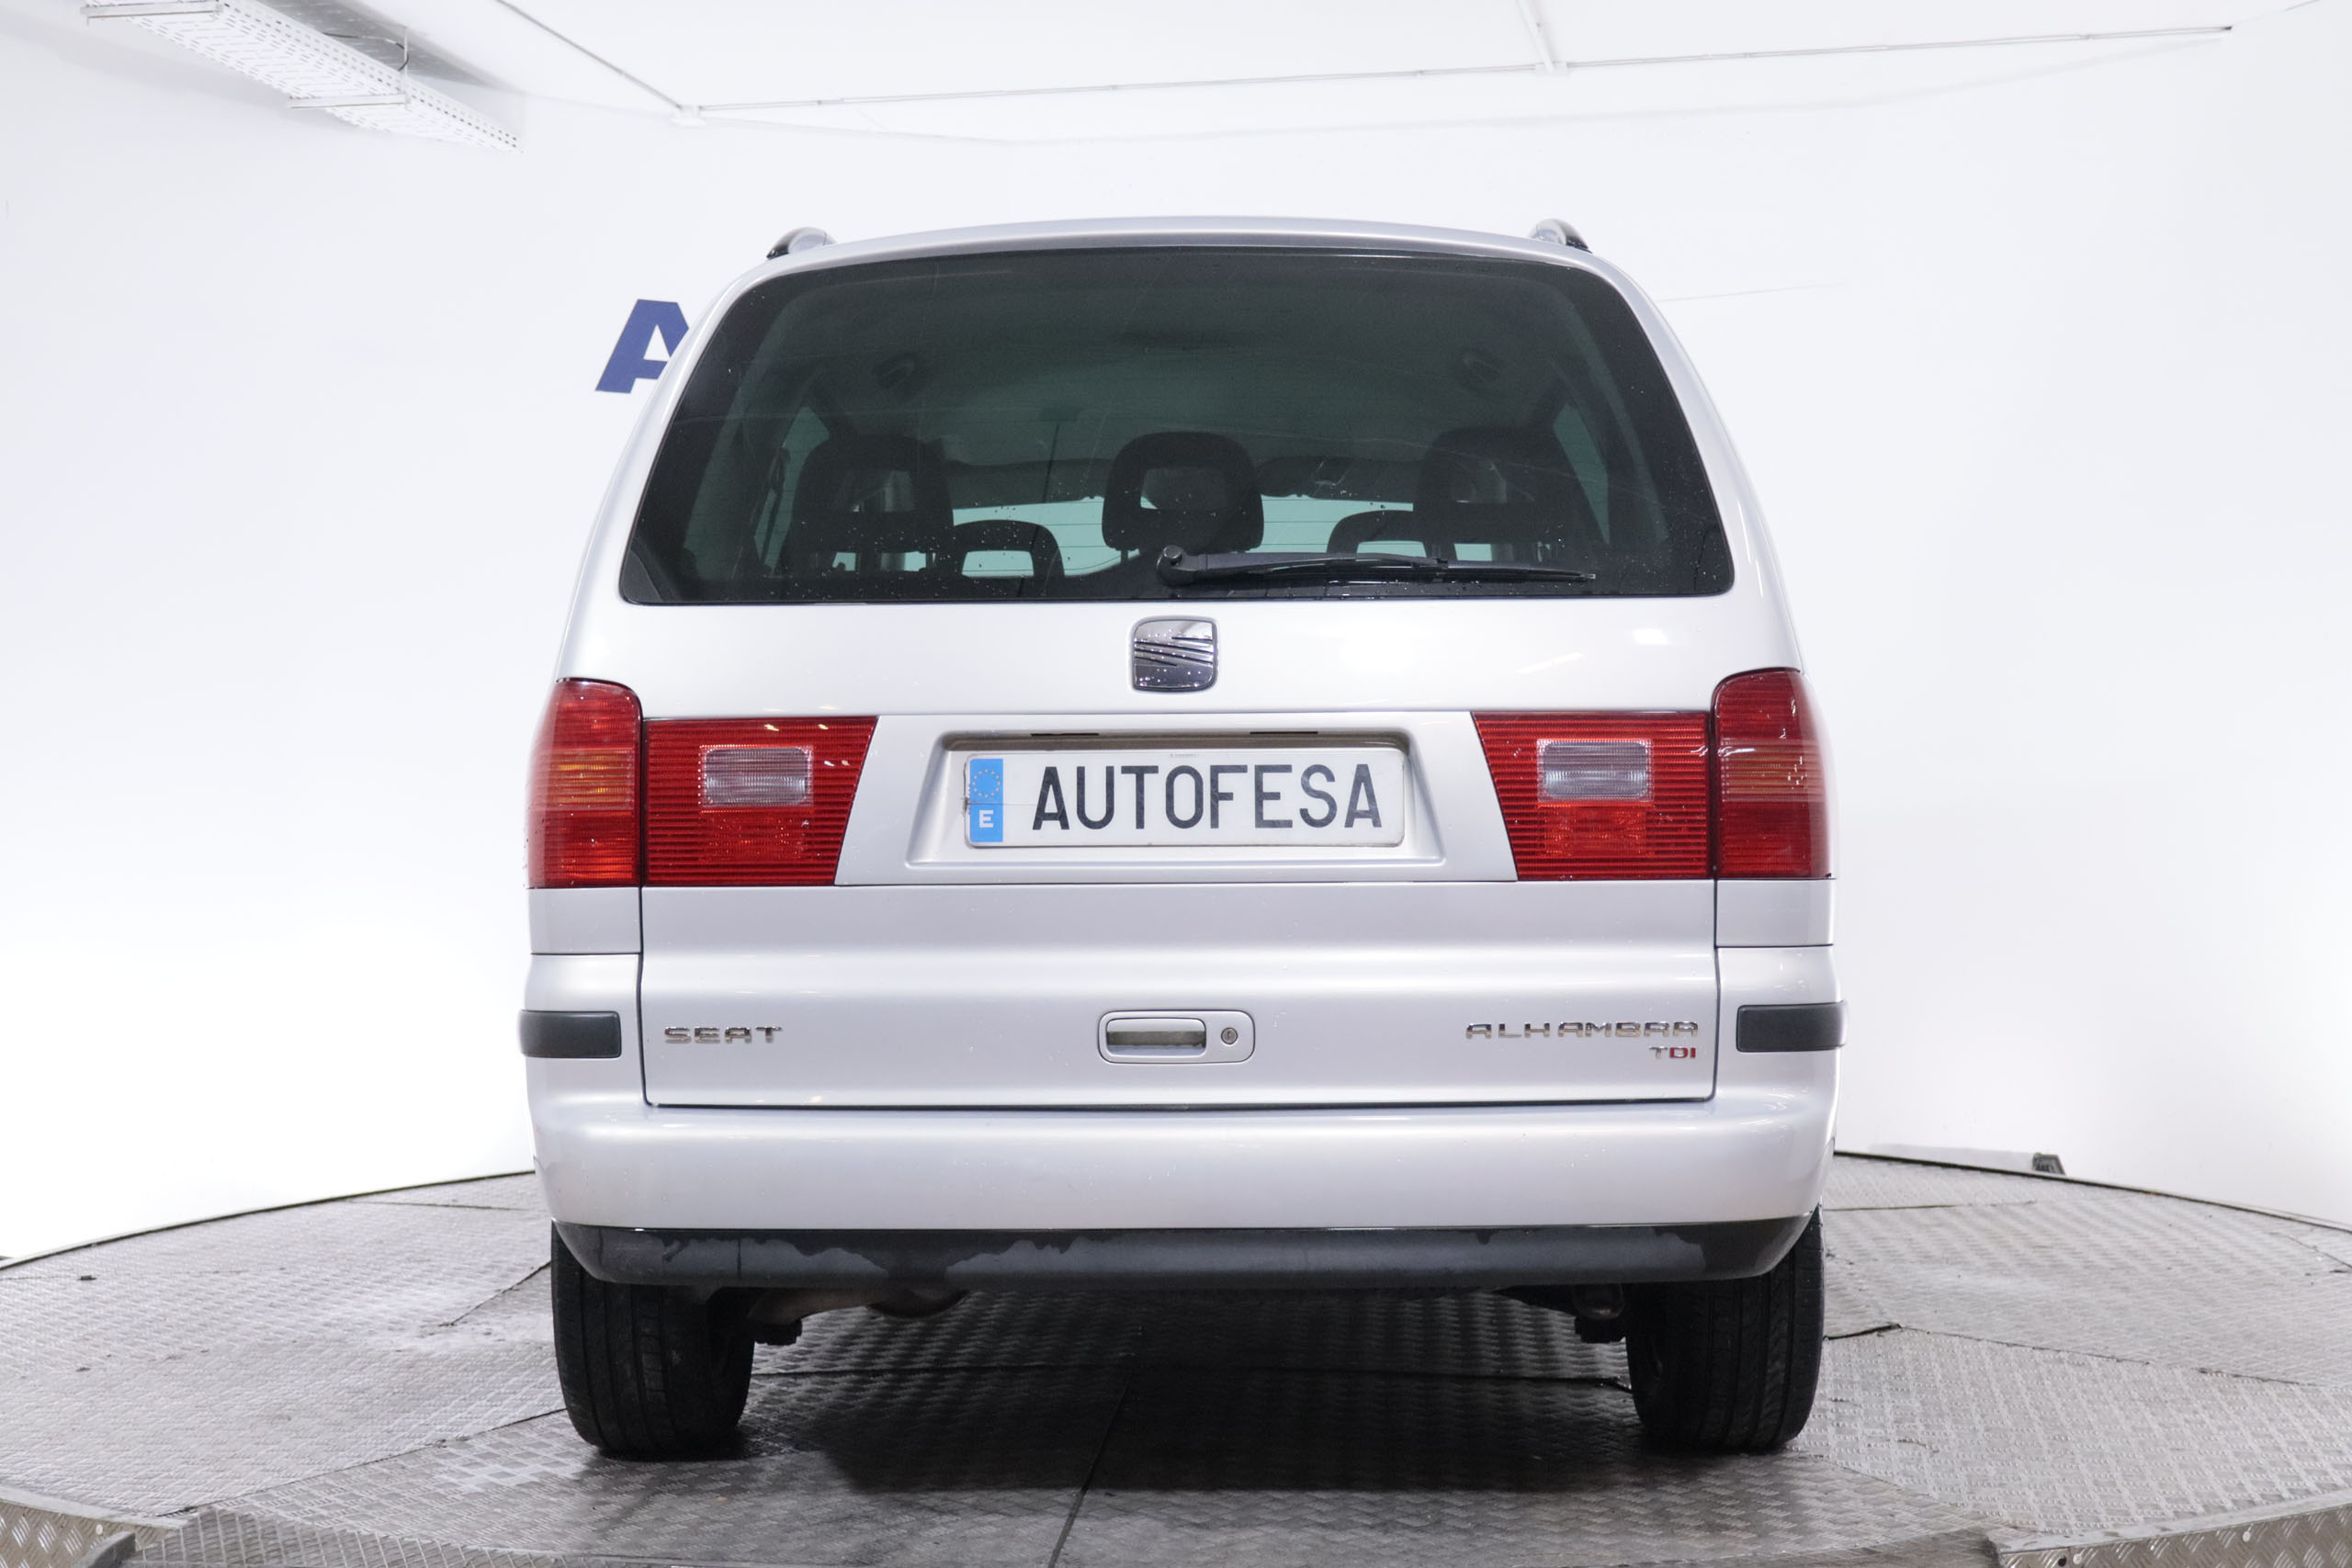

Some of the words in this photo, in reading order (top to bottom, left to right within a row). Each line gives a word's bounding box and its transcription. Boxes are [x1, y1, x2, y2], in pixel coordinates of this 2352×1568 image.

[1032, 764, 1382, 830] AUTOFESA
[979, 810, 994, 828] E
[664, 1027, 782, 1043] SEAT
[1466, 1021, 1699, 1039] ALHAMBRA
[1650, 1046, 1696, 1059] TDI
